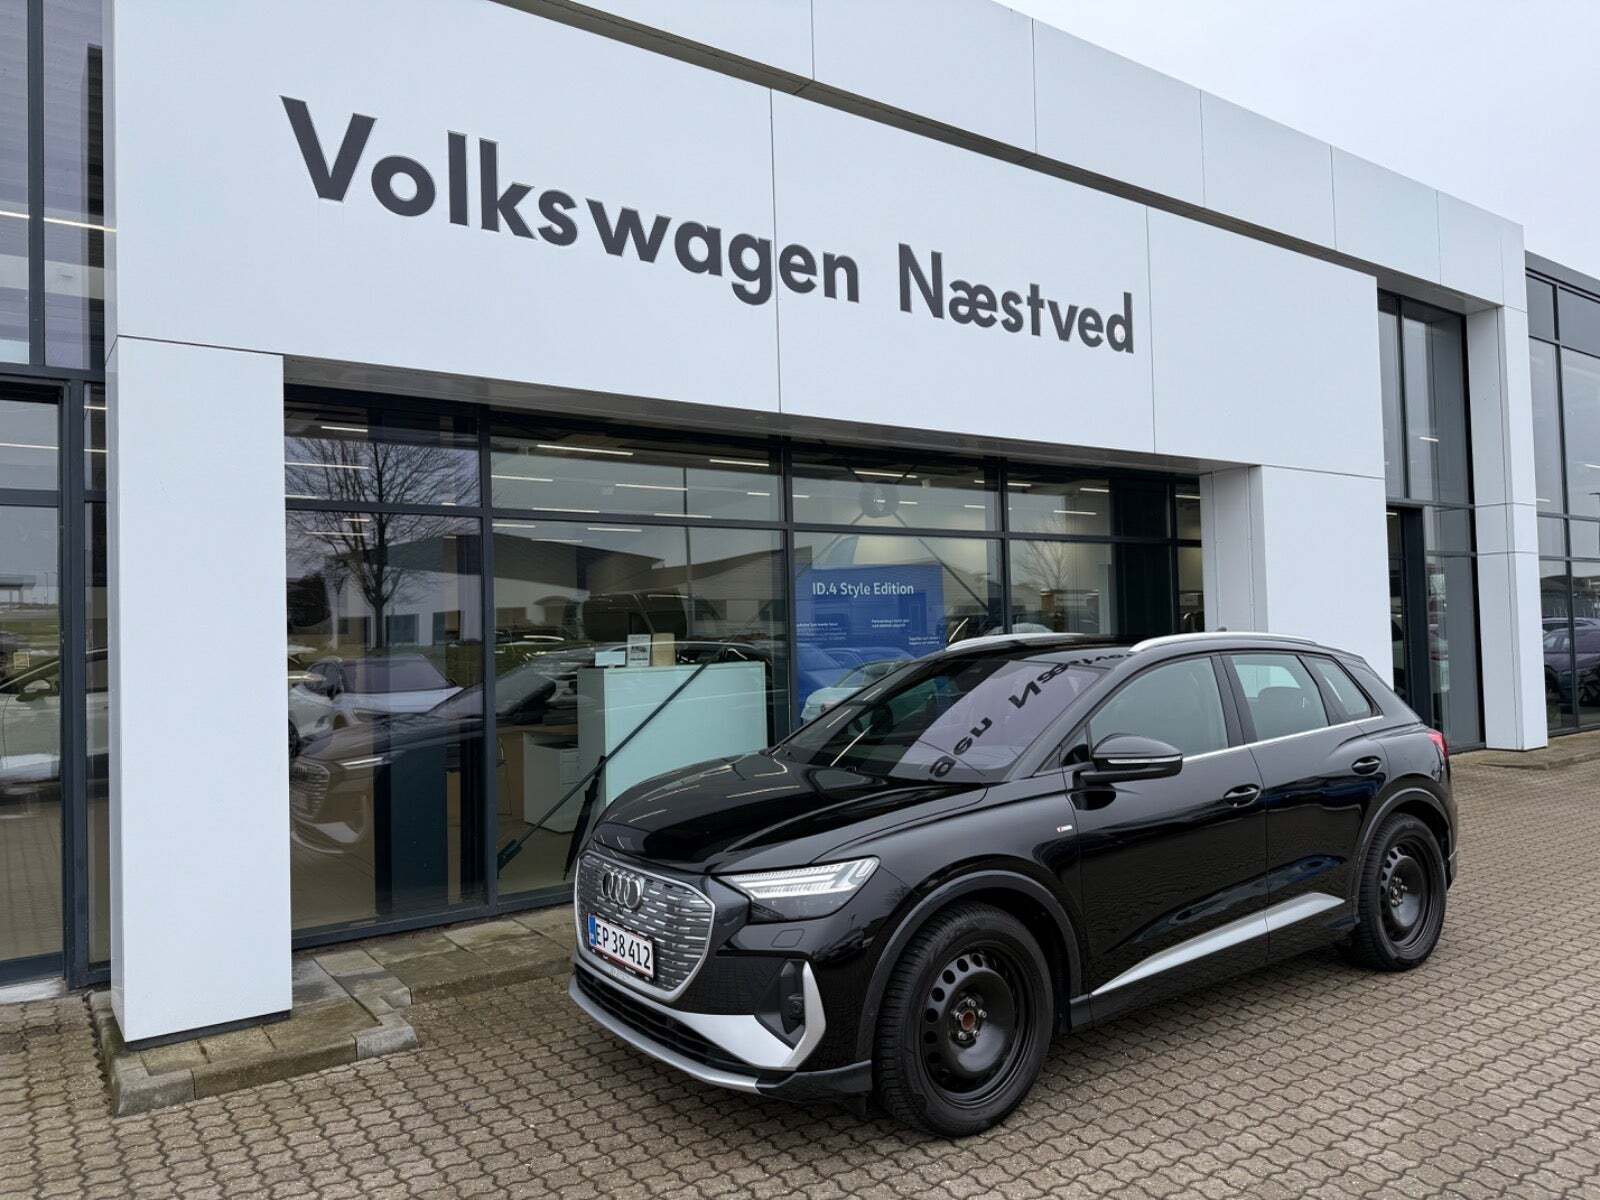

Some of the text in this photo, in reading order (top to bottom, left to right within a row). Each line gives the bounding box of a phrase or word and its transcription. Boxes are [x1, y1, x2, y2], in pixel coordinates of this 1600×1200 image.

[279, 95, 1134, 354] Volkswagen Næstved
[812, 582, 914, 598] ID.4 Style Edition
[596, 922, 609, 948] EP
